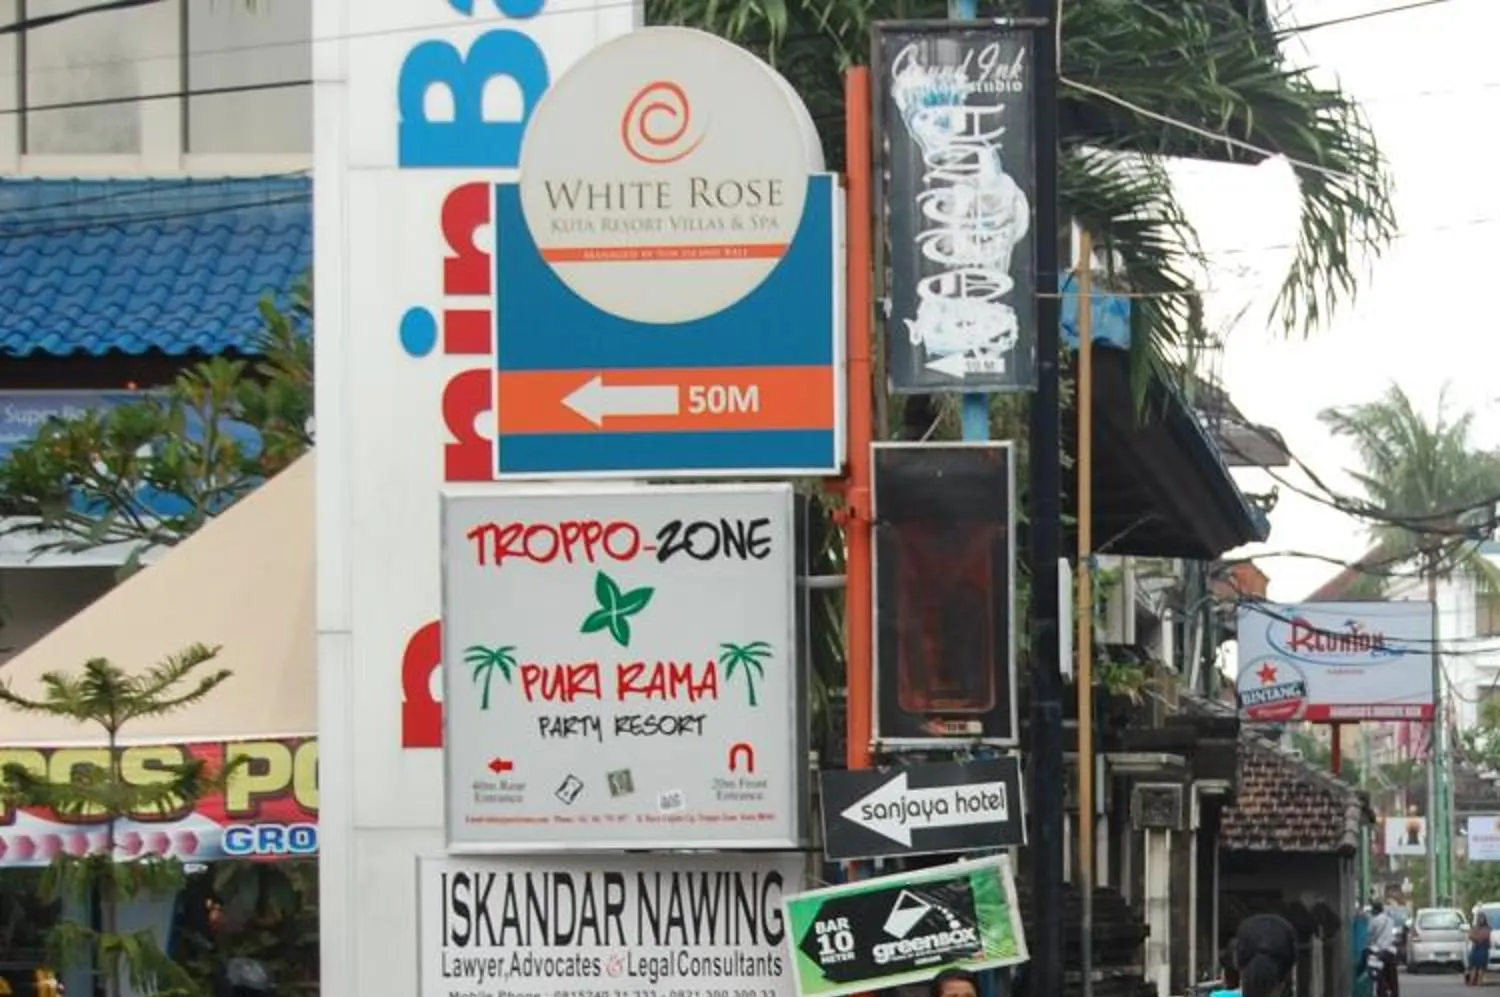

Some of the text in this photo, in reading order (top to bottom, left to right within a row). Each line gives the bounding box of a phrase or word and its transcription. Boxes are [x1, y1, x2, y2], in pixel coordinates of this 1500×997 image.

[545, 176, 784, 211] WHITE ROSE
[551, 214, 780, 234] KUTA RESORT VILLAS & SPA
[688, 384, 759, 415] 50M
[519, 660, 719, 703] PURI RAMA
[538, 714, 708, 743] PARTY RESORT
[861, 787, 1005, 824] sanjaya hotel
[441, 870, 786, 948] ISKANDAR NAWING
[815, 917, 850, 935] BAR
[816, 931, 855, 957] 10
[820, 950, 856, 965] METER
[605, 953, 625, 978] &
